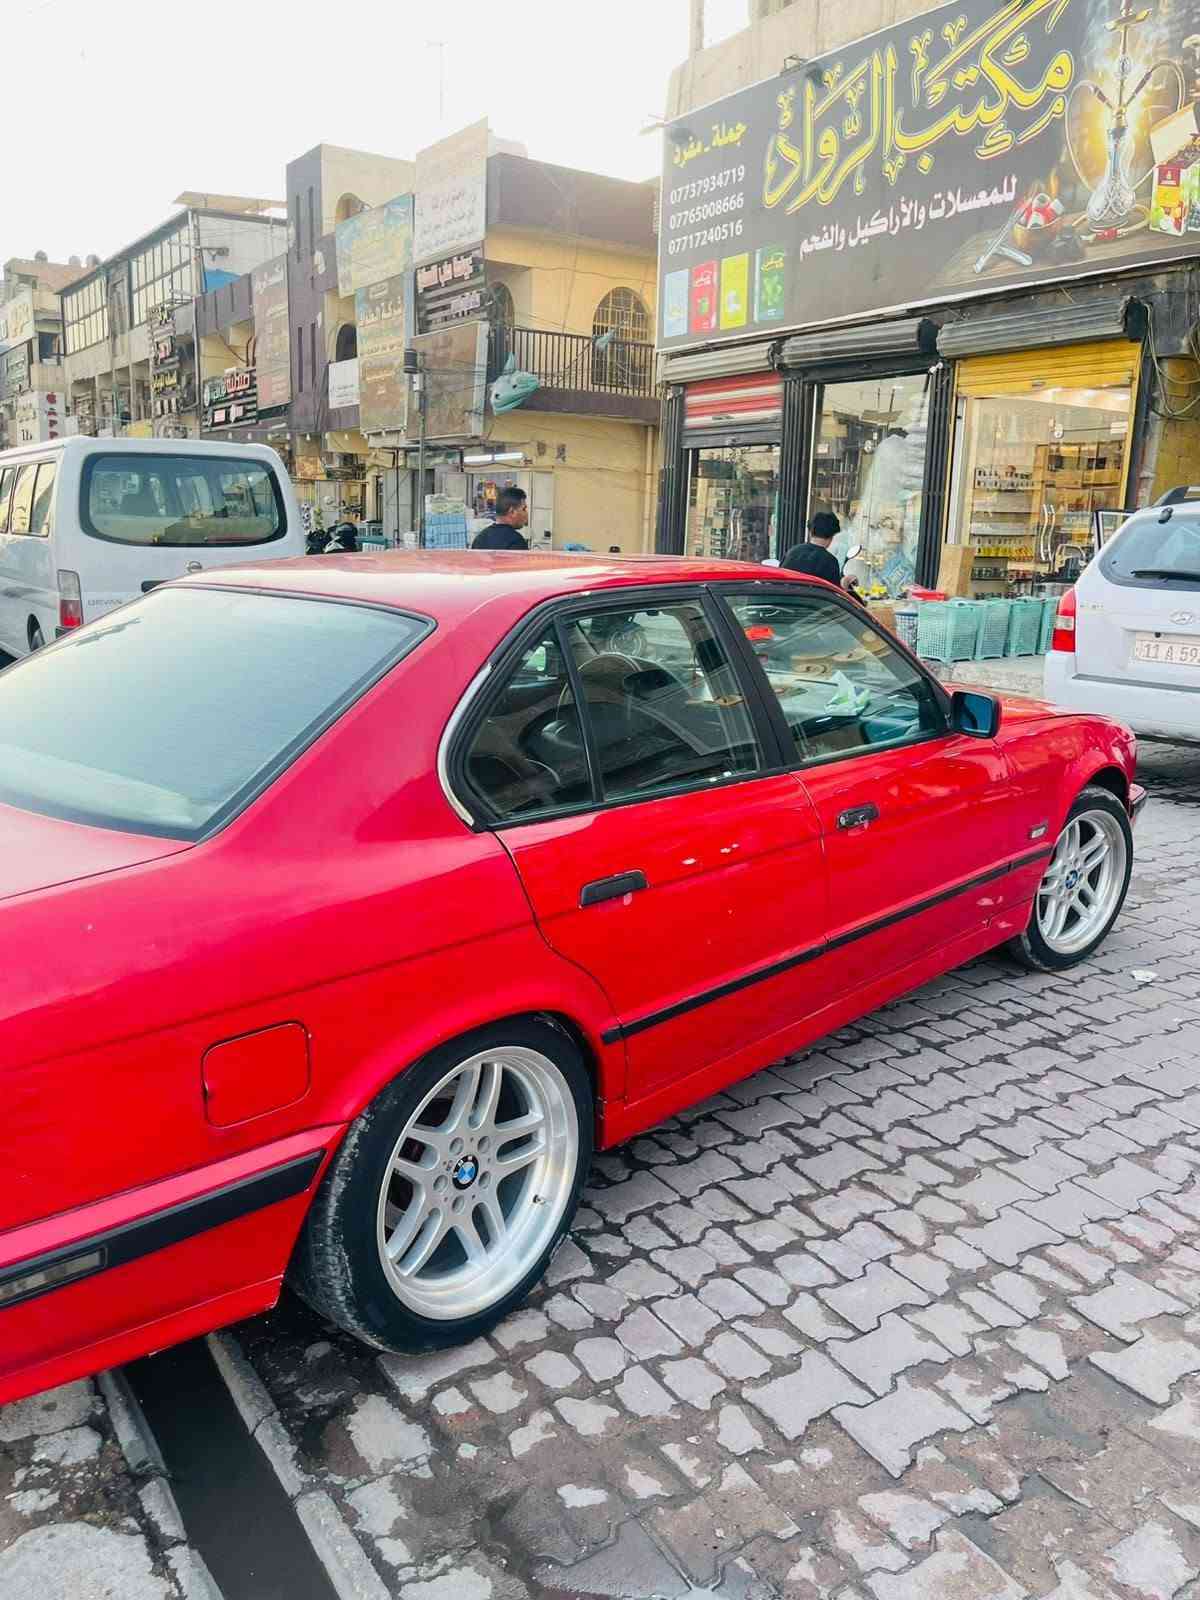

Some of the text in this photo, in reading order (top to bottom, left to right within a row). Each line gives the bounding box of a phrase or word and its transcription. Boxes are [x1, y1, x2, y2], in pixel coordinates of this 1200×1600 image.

[670, 165, 745, 205] 07737934719
[929, 174, 1018, 219] للمعسلات
[670, 192, 744, 230] 07765008666
[849, 195, 926, 248] والأراكيل
[668, 219, 743, 255] 07717240516
[799, 221, 846, 261] والفحم
[1144, 643, 1160, 659] 11
